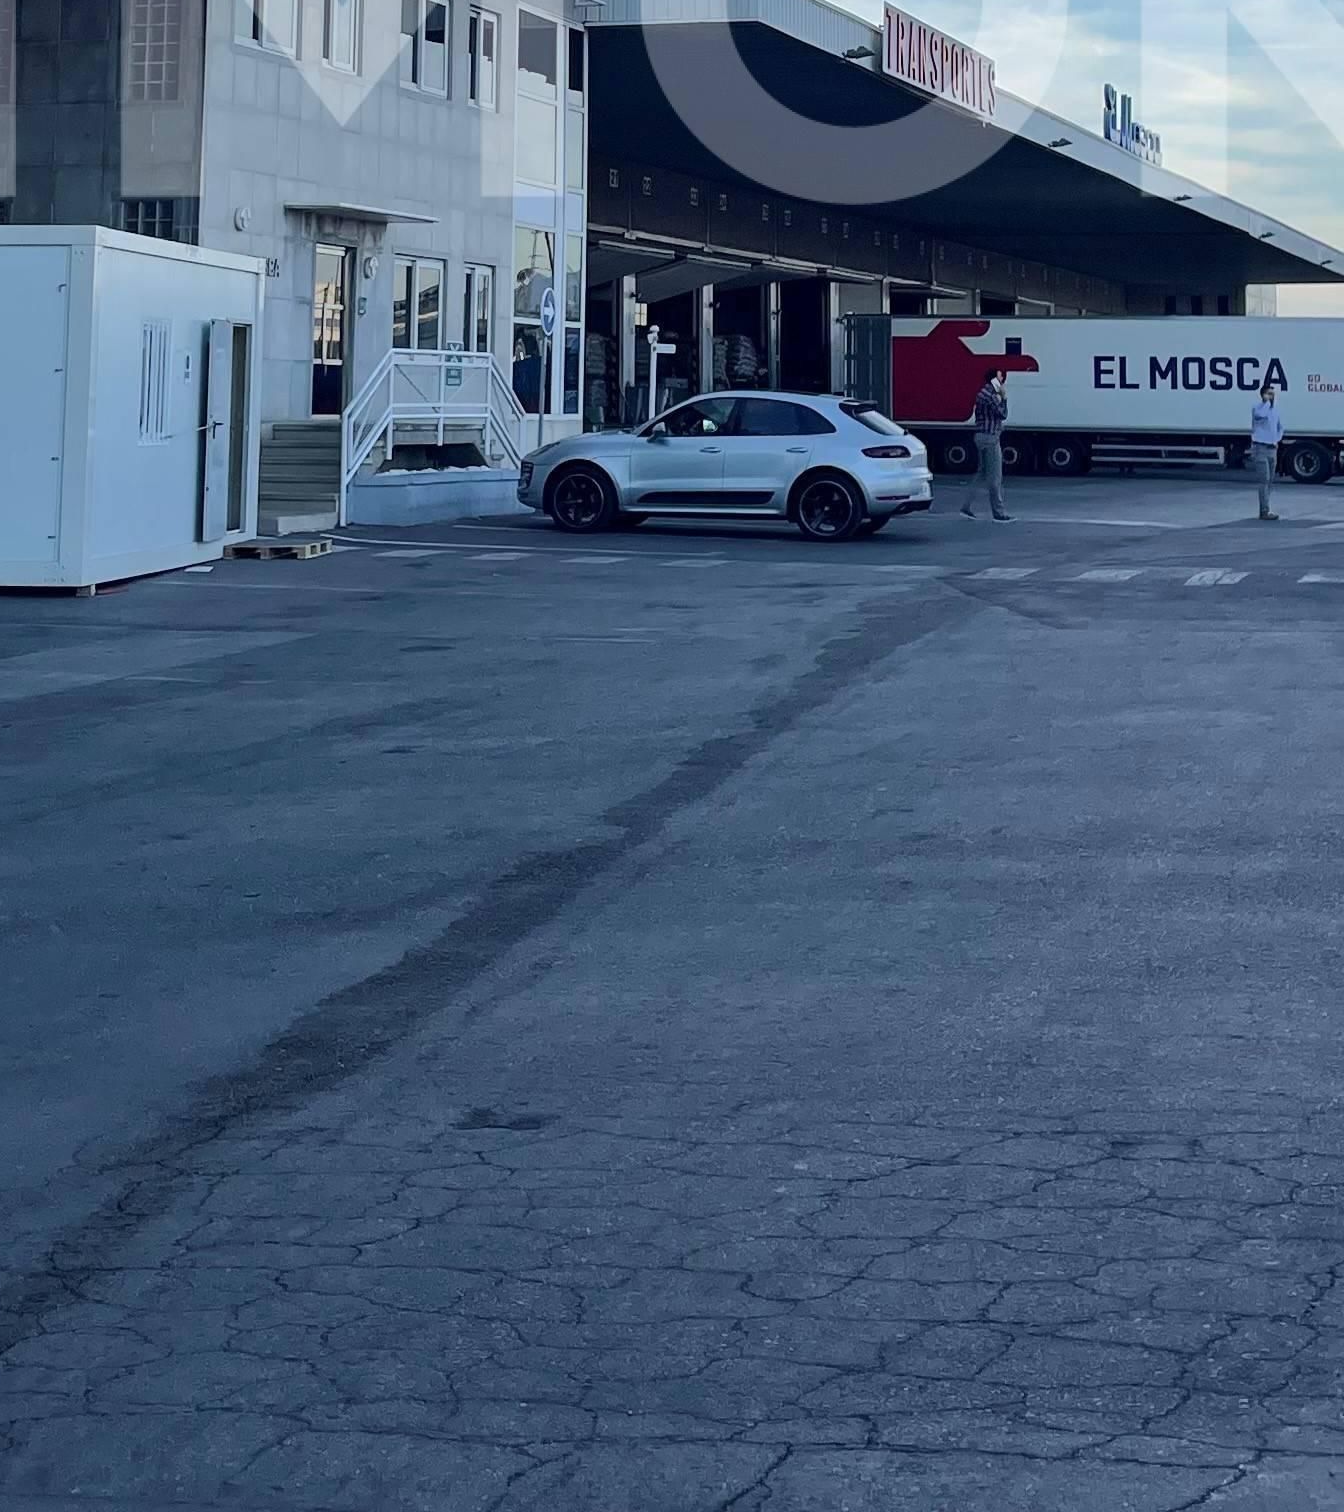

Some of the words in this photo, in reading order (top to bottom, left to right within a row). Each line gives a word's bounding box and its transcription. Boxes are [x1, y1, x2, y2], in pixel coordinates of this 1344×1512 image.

[885, 8, 996, 117] TRANSPORTES
[1093, 356, 1140, 389] EL
[1149, 356, 1288, 391] MOSCA
[1307, 374, 1321, 384] GO
[1307, 383, 1344, 393] GLOBAL
